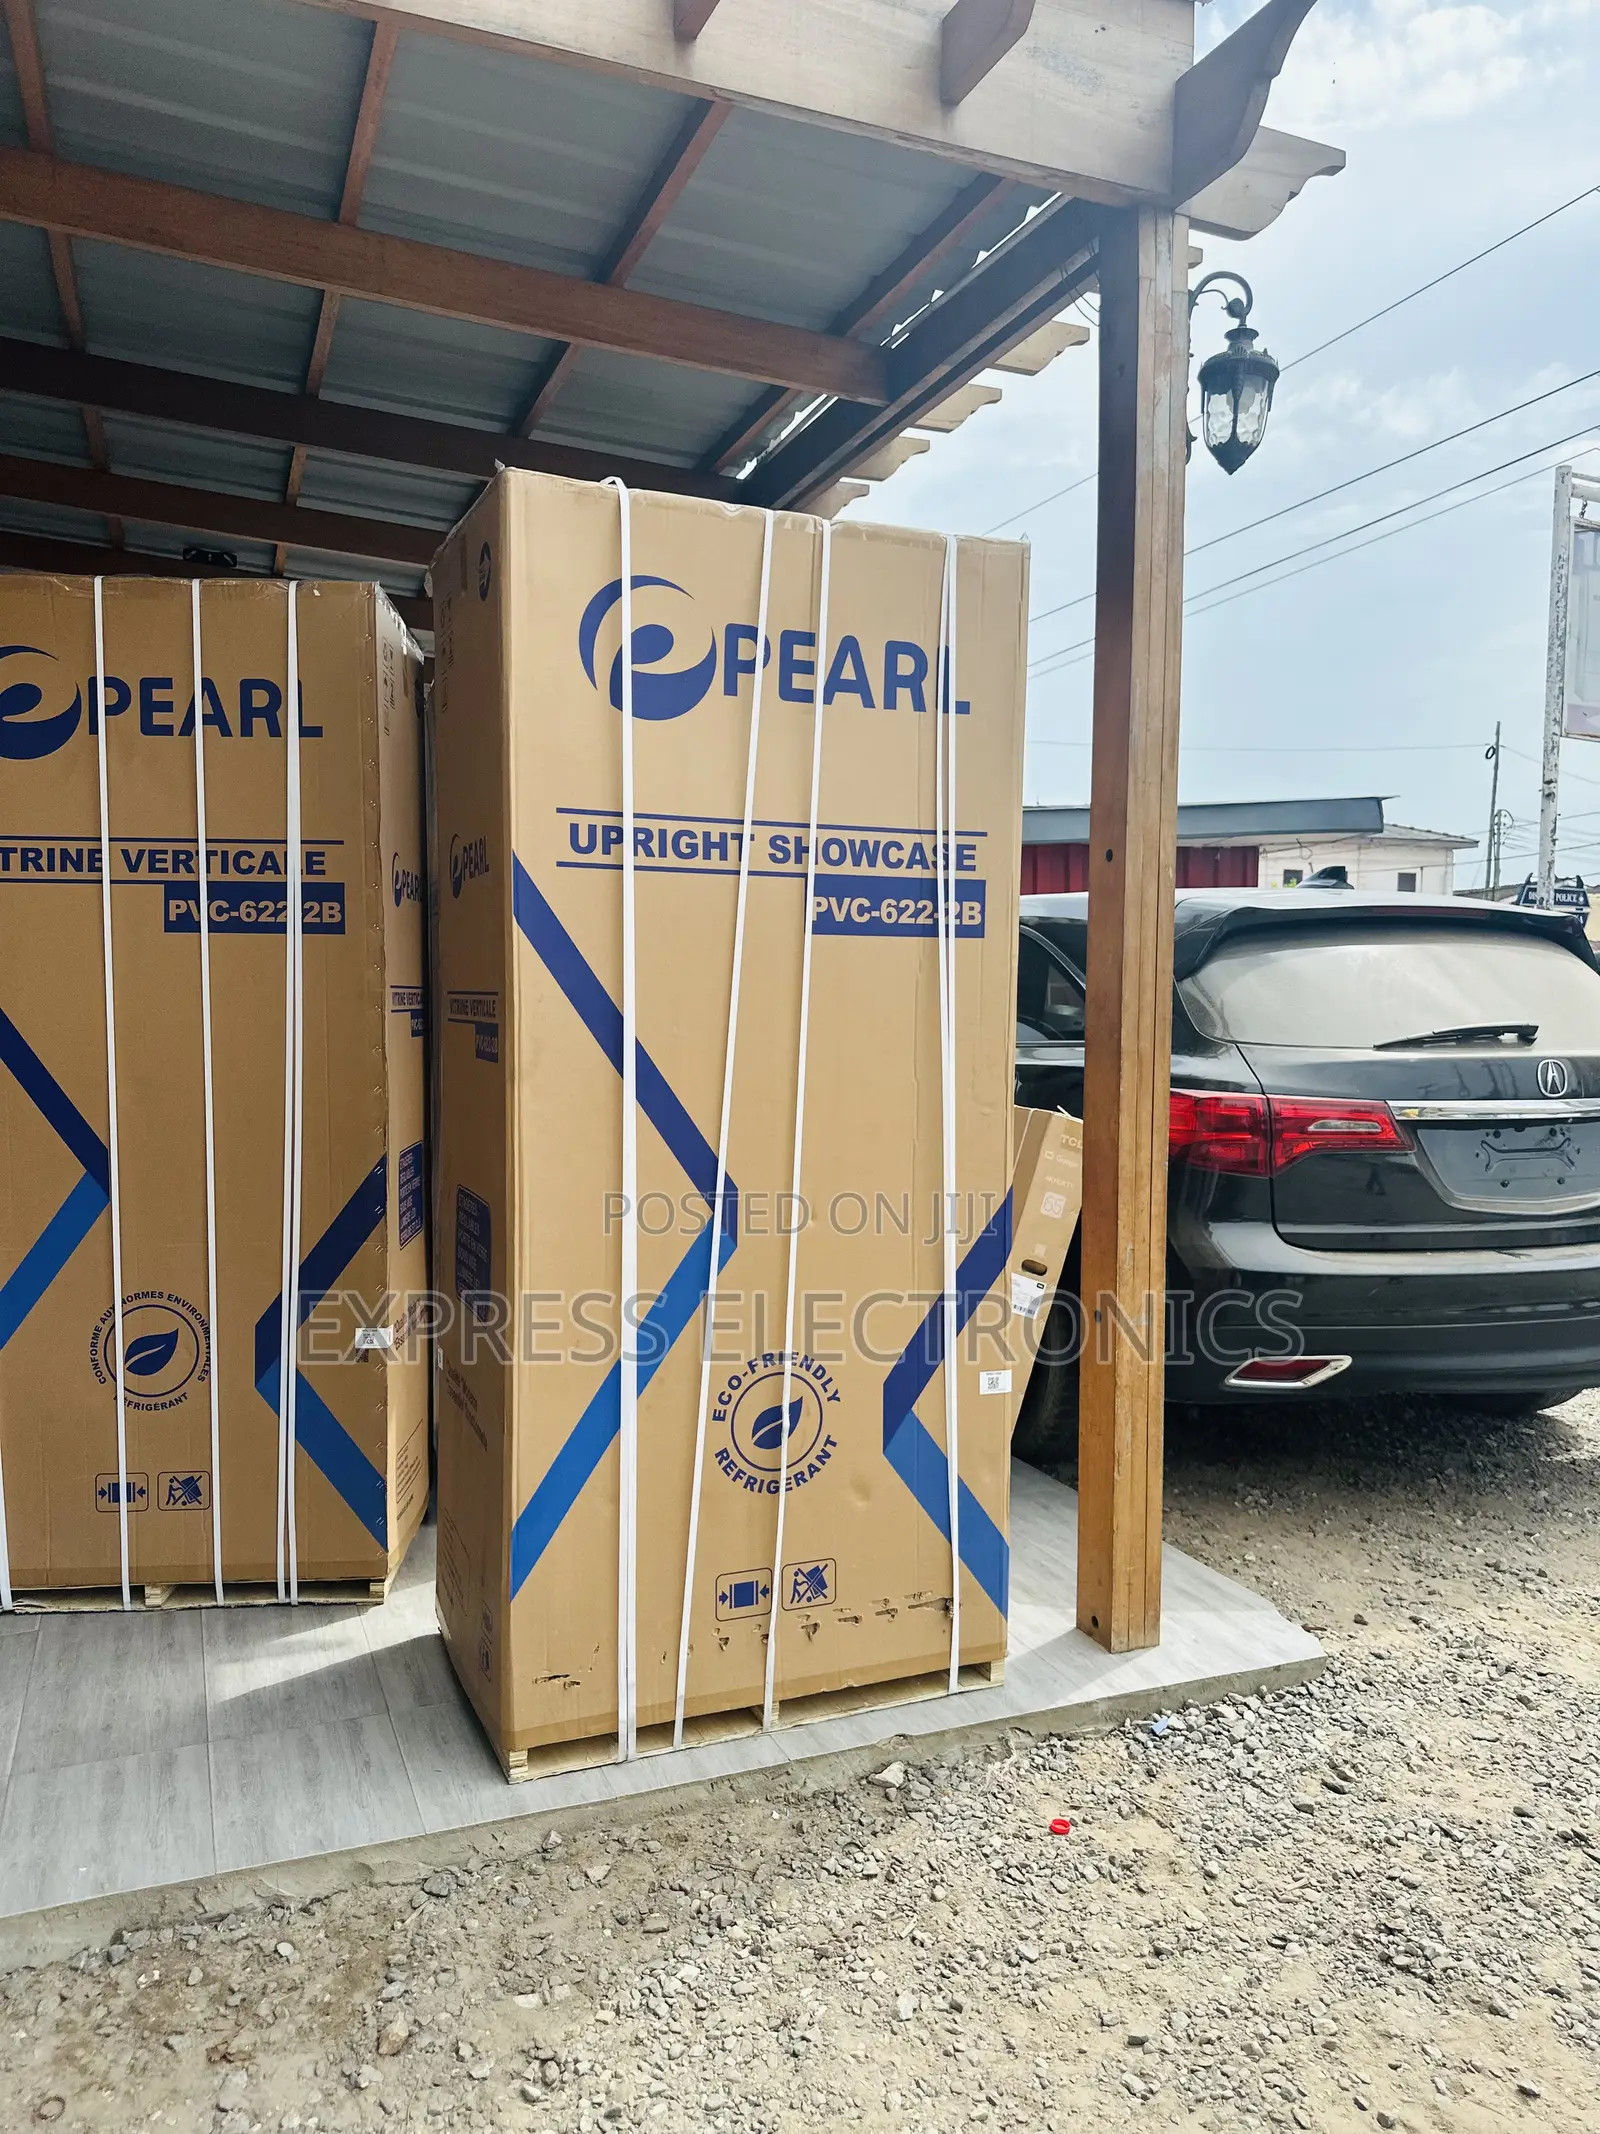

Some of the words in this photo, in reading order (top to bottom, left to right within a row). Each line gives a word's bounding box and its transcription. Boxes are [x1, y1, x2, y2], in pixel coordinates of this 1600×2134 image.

[724, 622, 971, 715] PEARL
[88, 676, 323, 738] PEARL
[463, 836, 490, 882] PEARL
[569, 822, 755, 863] UPRIGHT
[767, 834, 977, 872] SHOWCASE
[169, 900, 342, 923] PVC-6222B
[402, 868, 424, 903] PEAR
[90, 1325, 107, 1385] CONFORME
[712, 1351, 841, 1422] ECO-FRIENDLY
[714, 1434, 838, 1495] REFRIGERANT
